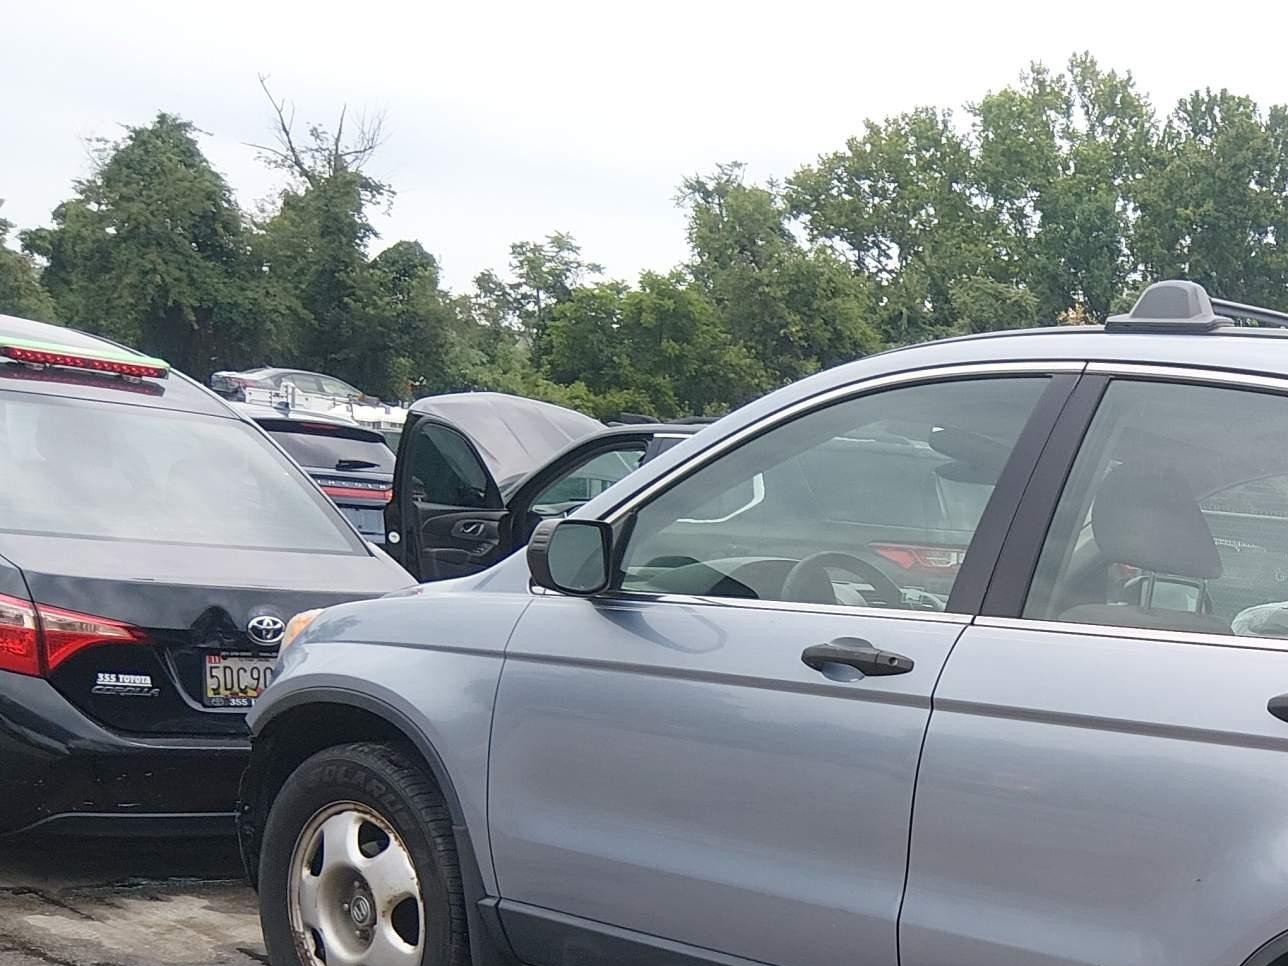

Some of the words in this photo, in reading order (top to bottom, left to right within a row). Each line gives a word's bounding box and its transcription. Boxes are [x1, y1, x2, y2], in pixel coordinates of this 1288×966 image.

[97, 672, 117, 682] 355
[117, 674, 152, 684] TOYOTA
[91, 685, 161, 697] COROLLA
[229, 698, 248, 706] 355
